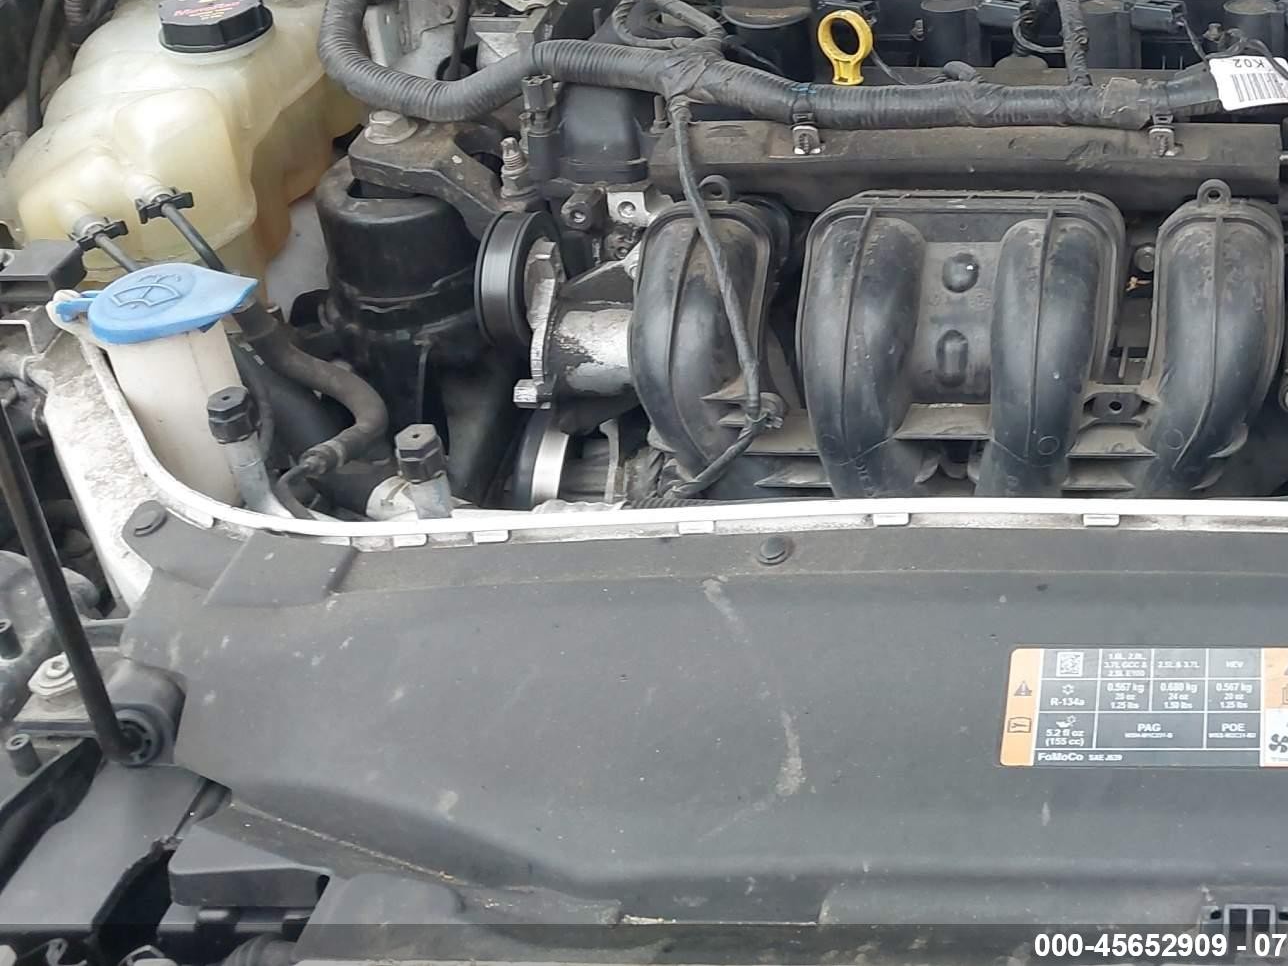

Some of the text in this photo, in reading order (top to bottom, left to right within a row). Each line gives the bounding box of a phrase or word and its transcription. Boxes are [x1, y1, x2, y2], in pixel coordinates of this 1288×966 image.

[1232, 57, 1265, 69] K02
[1132, 682, 1145, 694] kg
[1185, 682, 1198, 694] kg
[1240, 682, 1253, 694] kg
[1049, 697, 1085, 707] R-134a
[1136, 723, 1162, 732] PAG
[1221, 723, 1246, 732] POE
[1045, 729, 1061, 737] 5.2
[1071, 729, 1084, 737] oz
[1045, 737, 1084, 747] (155 cc)
[1037, 752, 1085, 762] FoMoCo
